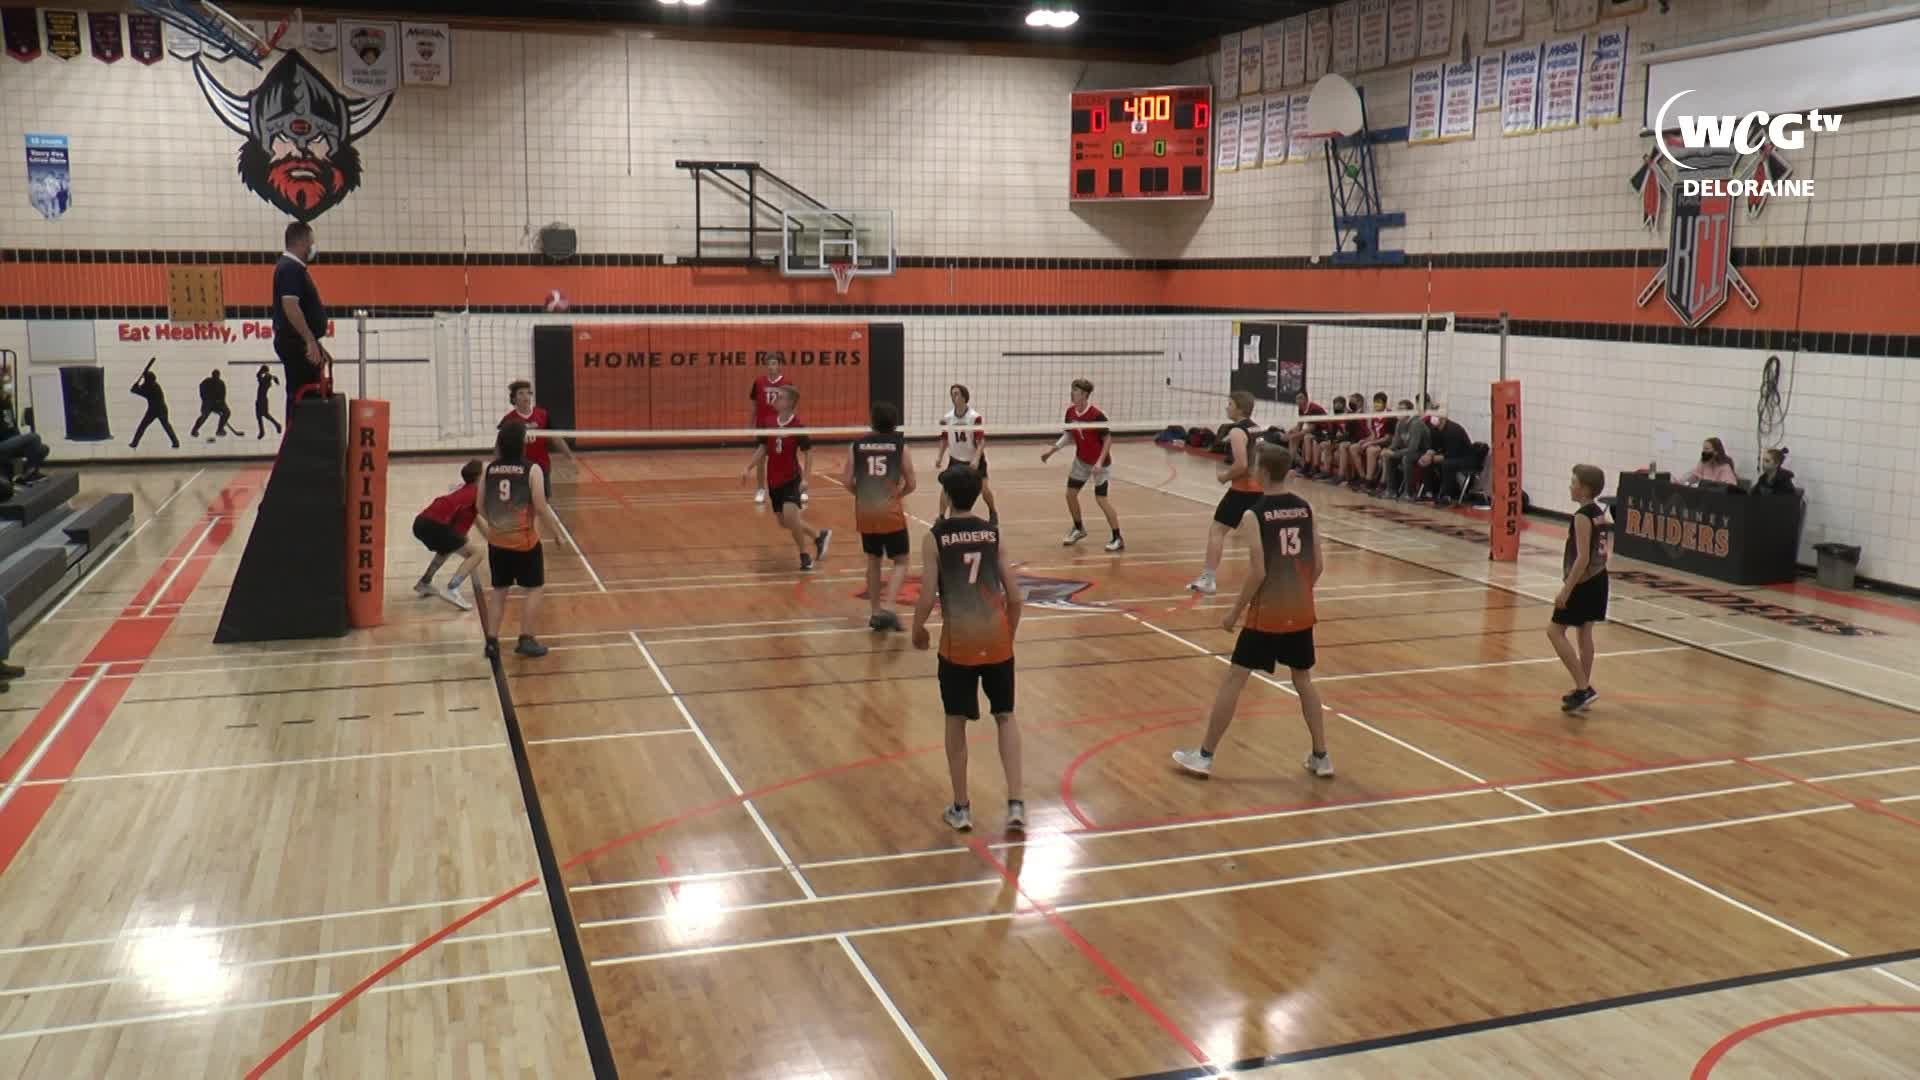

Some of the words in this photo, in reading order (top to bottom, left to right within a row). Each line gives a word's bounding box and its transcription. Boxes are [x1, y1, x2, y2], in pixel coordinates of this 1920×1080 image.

[1092, 107, 1105, 133] 0
[1194, 103, 1208, 129] 0
[1113, 141, 1123, 159] 0
[1155, 139, 1166, 157] 0
[118, 323, 150, 341] Eat
[155, 322, 237, 344] Healthy,
[242, 322, 273, 339] Pla
[584, 351, 663, 368] HOME
[670, 351, 700, 367] OF
[708, 351, 747, 367] THE
[867, 455, 888, 476] 15
[1506, 403, 1518, 537] RAIDERS
[499, 478, 512, 502] 9
[359, 426, 376, 593] RAIDERS
[1264, 507, 1309, 522] RAIDERS
[941, 529, 998, 546] RAIDERS
[1279, 527, 1302, 556] 13
[1625, 507, 1729, 558] RAIDERS
[963, 551, 982, 584] 7
